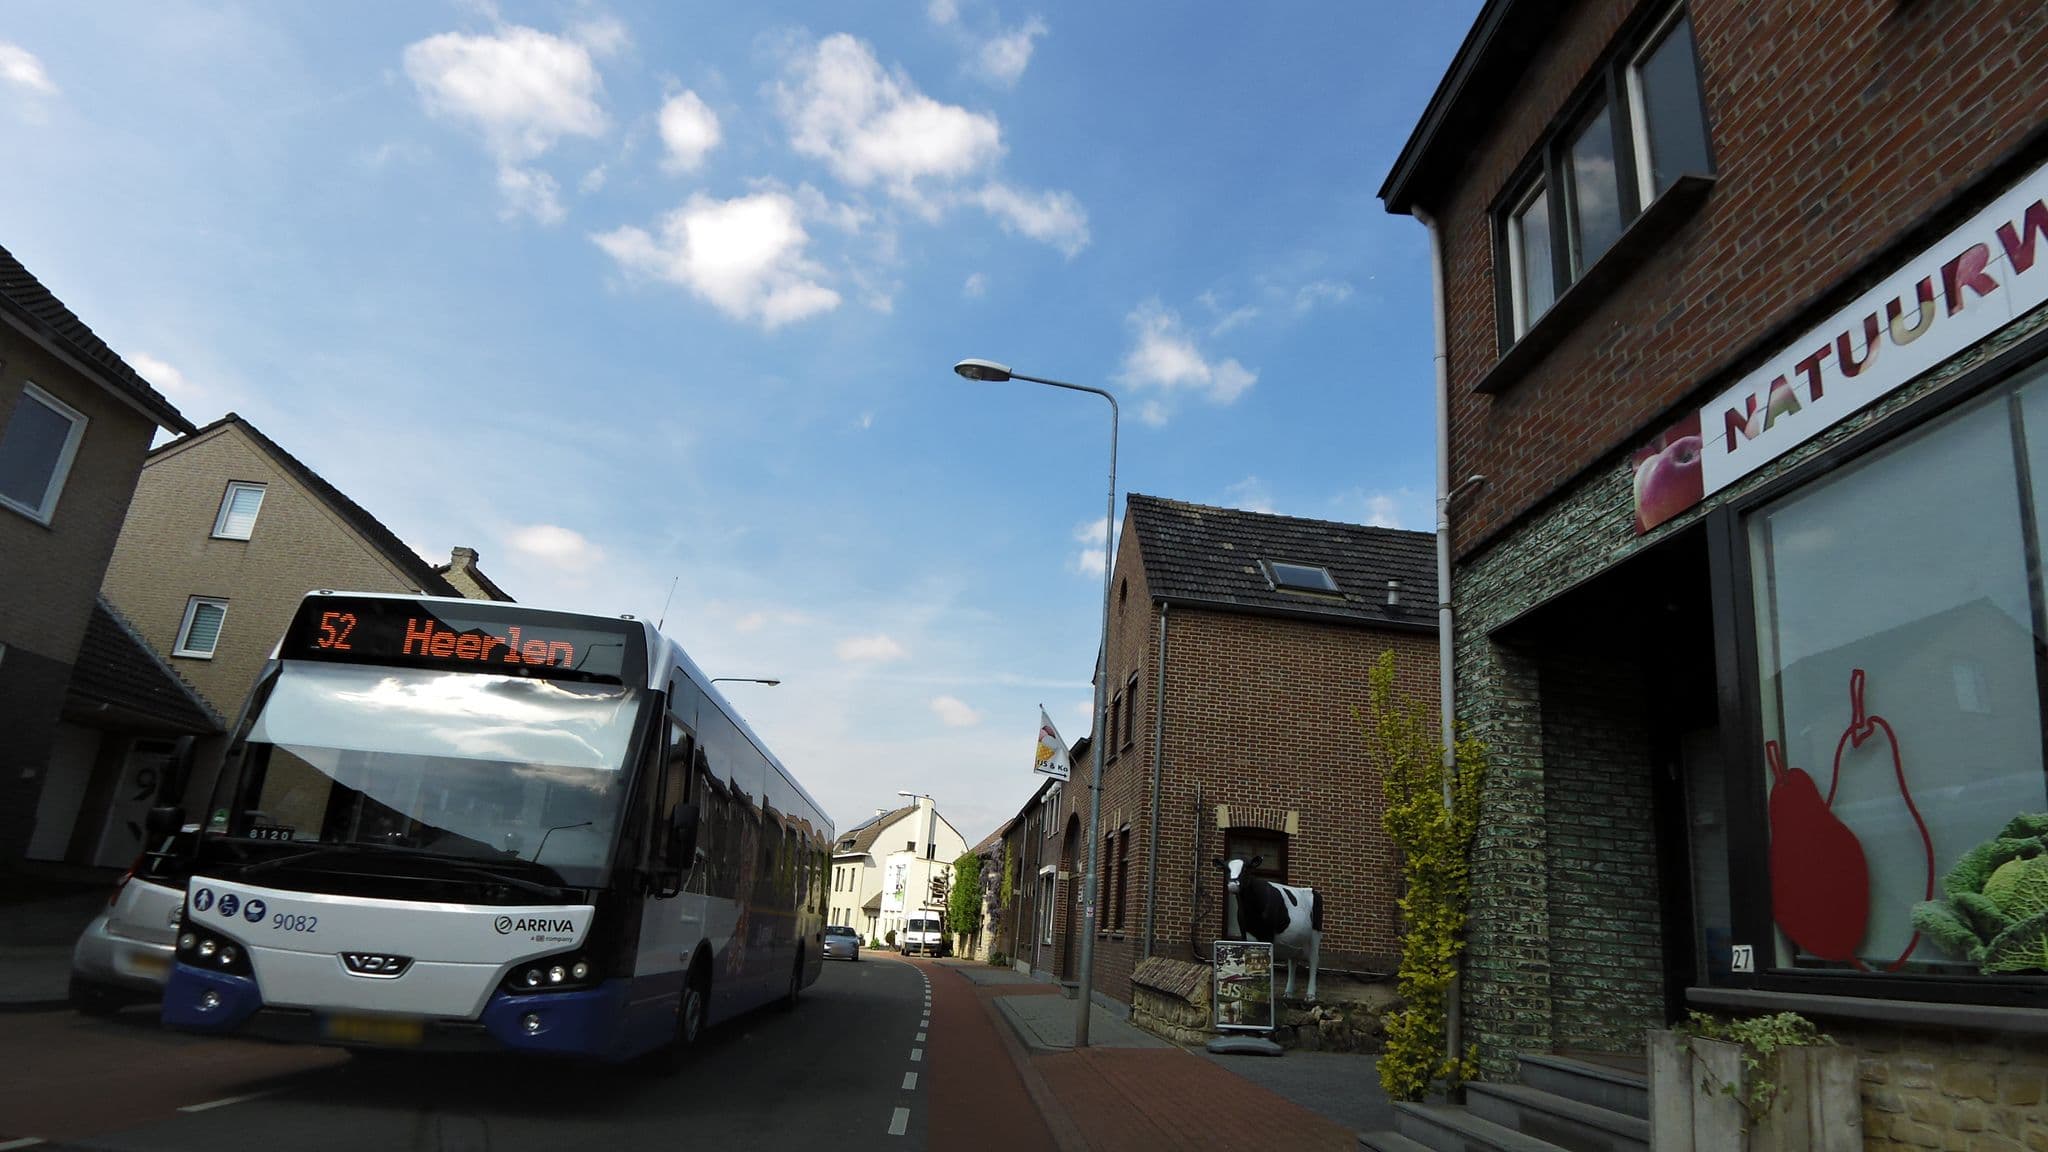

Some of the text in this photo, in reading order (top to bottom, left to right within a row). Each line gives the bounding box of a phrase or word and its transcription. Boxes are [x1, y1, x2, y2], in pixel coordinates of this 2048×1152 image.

[318, 612, 574, 668] 52 Heerlen
[249, 829, 289, 841] 8120
[272, 913, 318, 933] 9082
[515, 918, 574, 932] ARRIVA
[1733, 949, 1750, 969] 27
